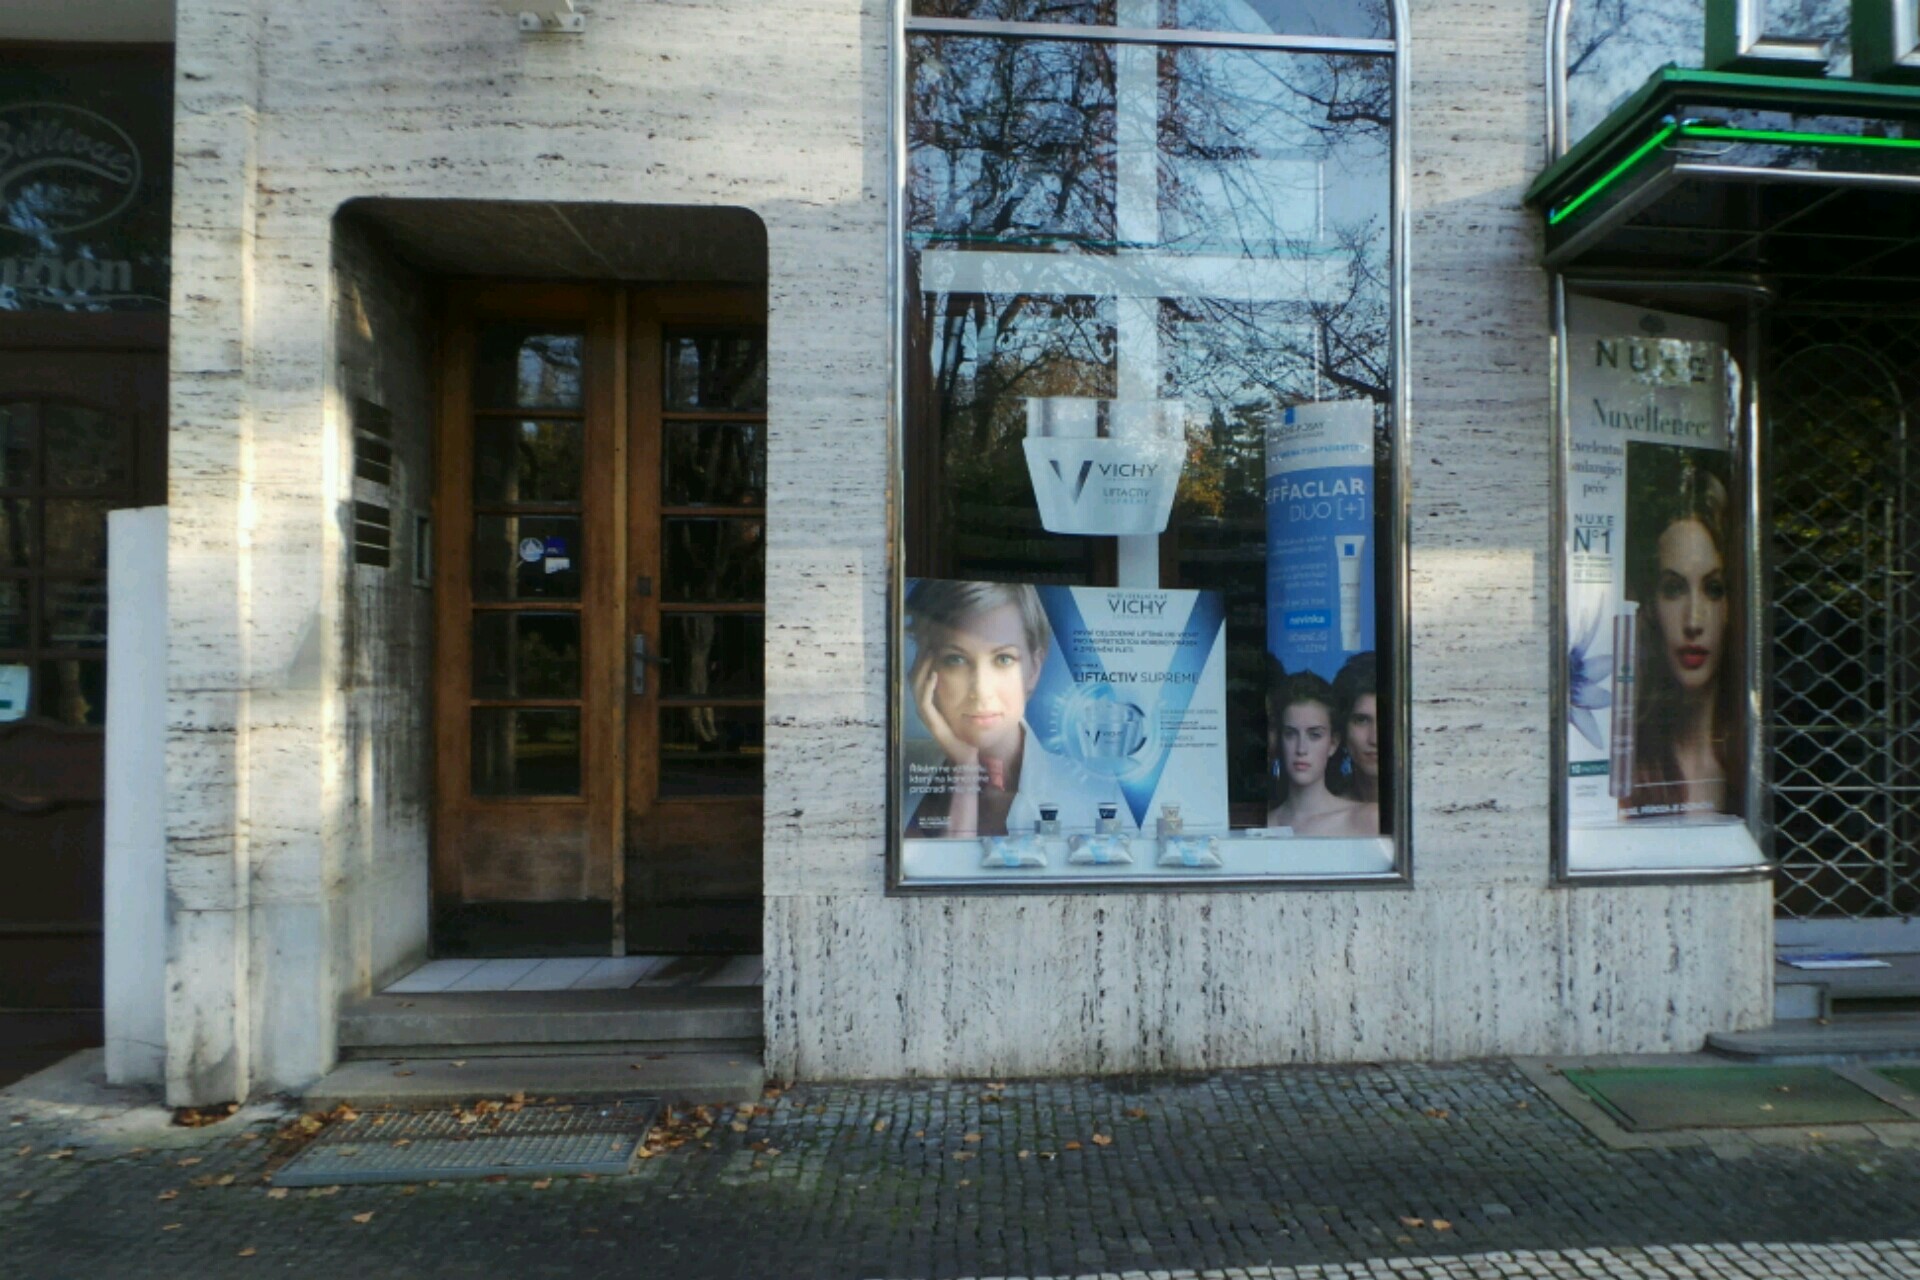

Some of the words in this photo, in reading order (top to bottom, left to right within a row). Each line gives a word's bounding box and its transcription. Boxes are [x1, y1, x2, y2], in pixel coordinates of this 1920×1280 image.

[1595, 338, 1707, 382] NUXE
[1098, 463, 1158, 478] VICHY
[1103, 487, 1151, 498] LIFTACTIV
[1265, 477, 1366, 505] EFFACLAR
[1289, 501, 1333, 522] DUO
[1573, 514, 1615, 527] NUXE
[1107, 600, 1168, 615] VICHY
[1072, 672, 1138, 684] LIFTACTIV
[1140, 672, 1201, 684] SUPREME
